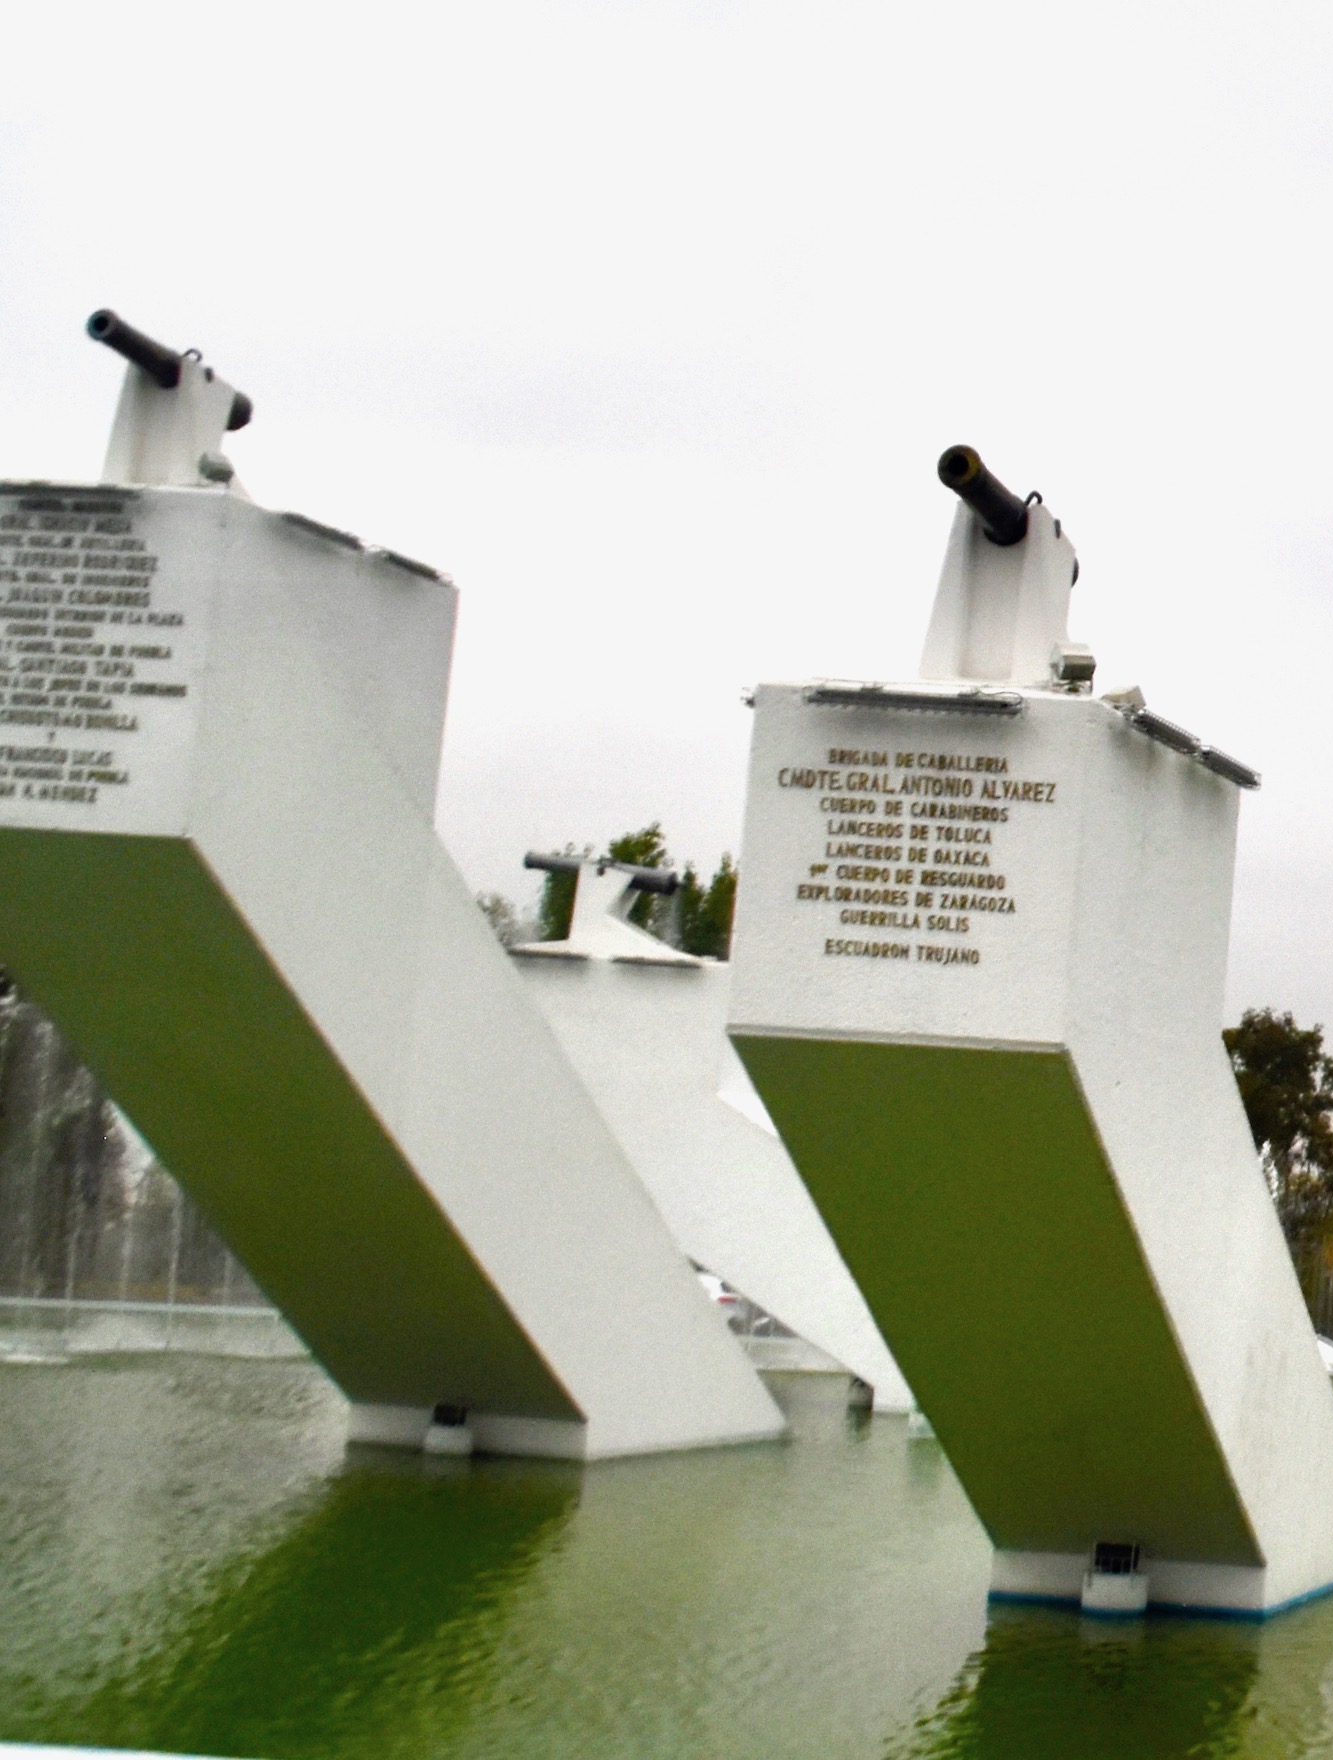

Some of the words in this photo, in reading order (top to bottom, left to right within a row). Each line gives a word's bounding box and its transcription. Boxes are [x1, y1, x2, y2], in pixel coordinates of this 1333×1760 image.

[828, 748, 888, 767] BRIGADA
[895, 752, 914, 768] DE
[917, 752, 1008, 774] CABALLERIA
[900, 775, 973, 798] ANTONIO
[981, 780, 1056, 803] ALVAREZ
[820, 797, 876, 814] CUERPO
[884, 800, 903, 817] DE
[910, 801, 1009, 823] CARABINEROS
[827, 819, 903, 838] LANCEROS
[909, 824, 928, 840] DE
[936, 825, 991, 845] TOLUCA
[826, 841, 902, 861] LANCEROS
[907, 846, 928, 863] DE
[933, 848, 990, 867] OAXACA
[836, 864, 890, 883] CUERPO
[895, 868, 914, 885] DE
[920, 869, 1006, 890] RESGUARDO
[797, 883, 908, 906] EXPLORADORES
[914, 890, 933, 909] DE
[939, 892, 1016, 914] ZARAGOZA
[840, 908, 921, 929] GUERRILLA
[927, 914, 970, 933] SOLIS
[824, 938, 910, 960] ESCUADRON
[916, 944, 980, 966] TRUJANO
